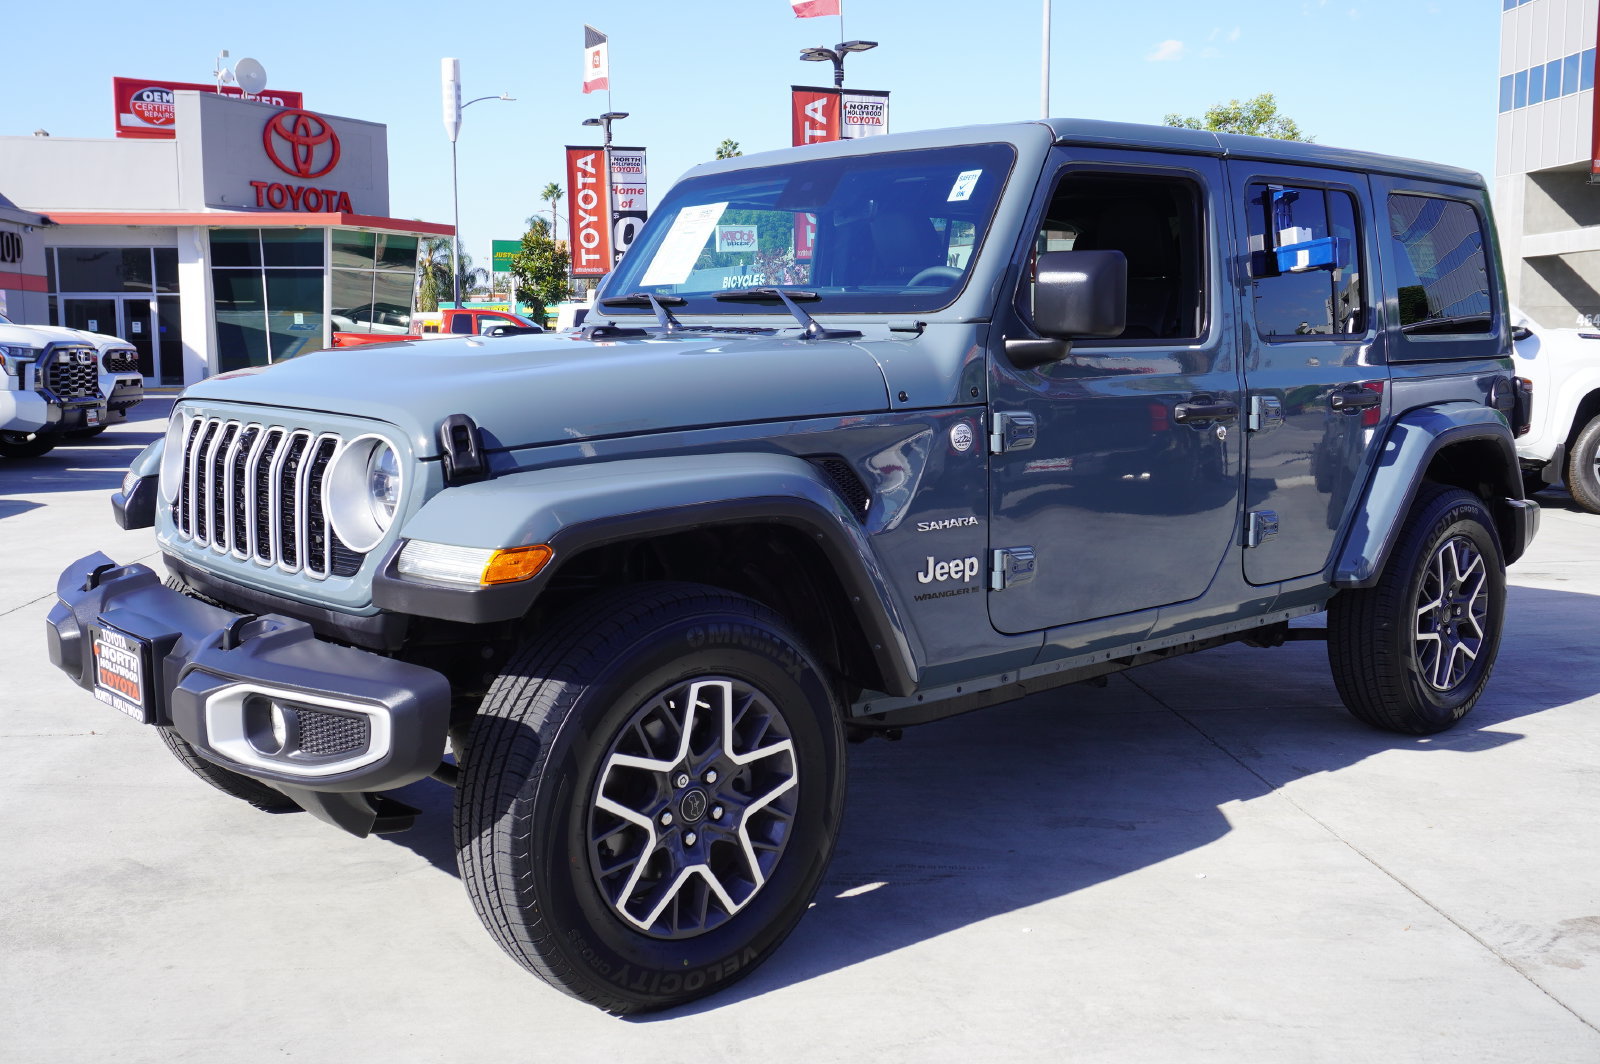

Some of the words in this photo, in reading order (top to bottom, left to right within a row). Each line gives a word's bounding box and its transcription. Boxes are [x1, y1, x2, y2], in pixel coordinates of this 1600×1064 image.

[142, 91, 174, 103] OEM
[135, 103, 175, 113] CERTIFIE
[144, 111, 174, 119] REPAIRS
[847, 116, 881, 125] TOYOTA
[250, 181, 354, 214] TOYOTA
[612, 185, 645, 195] Home
[576, 153, 600, 266] TOYOTA
[621, 199, 634, 208] of
[0, 231, 24, 263] OD
[722, 273, 766, 288] BICYCLES
[917, 516, 979, 532] SAHARA
[917, 555, 979, 584] Jeep
[914, 587, 970, 602] WRANGLER
[101, 628, 127, 650] TOYOTA
[101, 645, 137, 672] NORTH
[100, 657, 138, 683] HOLLYWOOD
[100, 669, 141, 701] TOYOTA
[611, 945, 759, 994] VELOCITY
